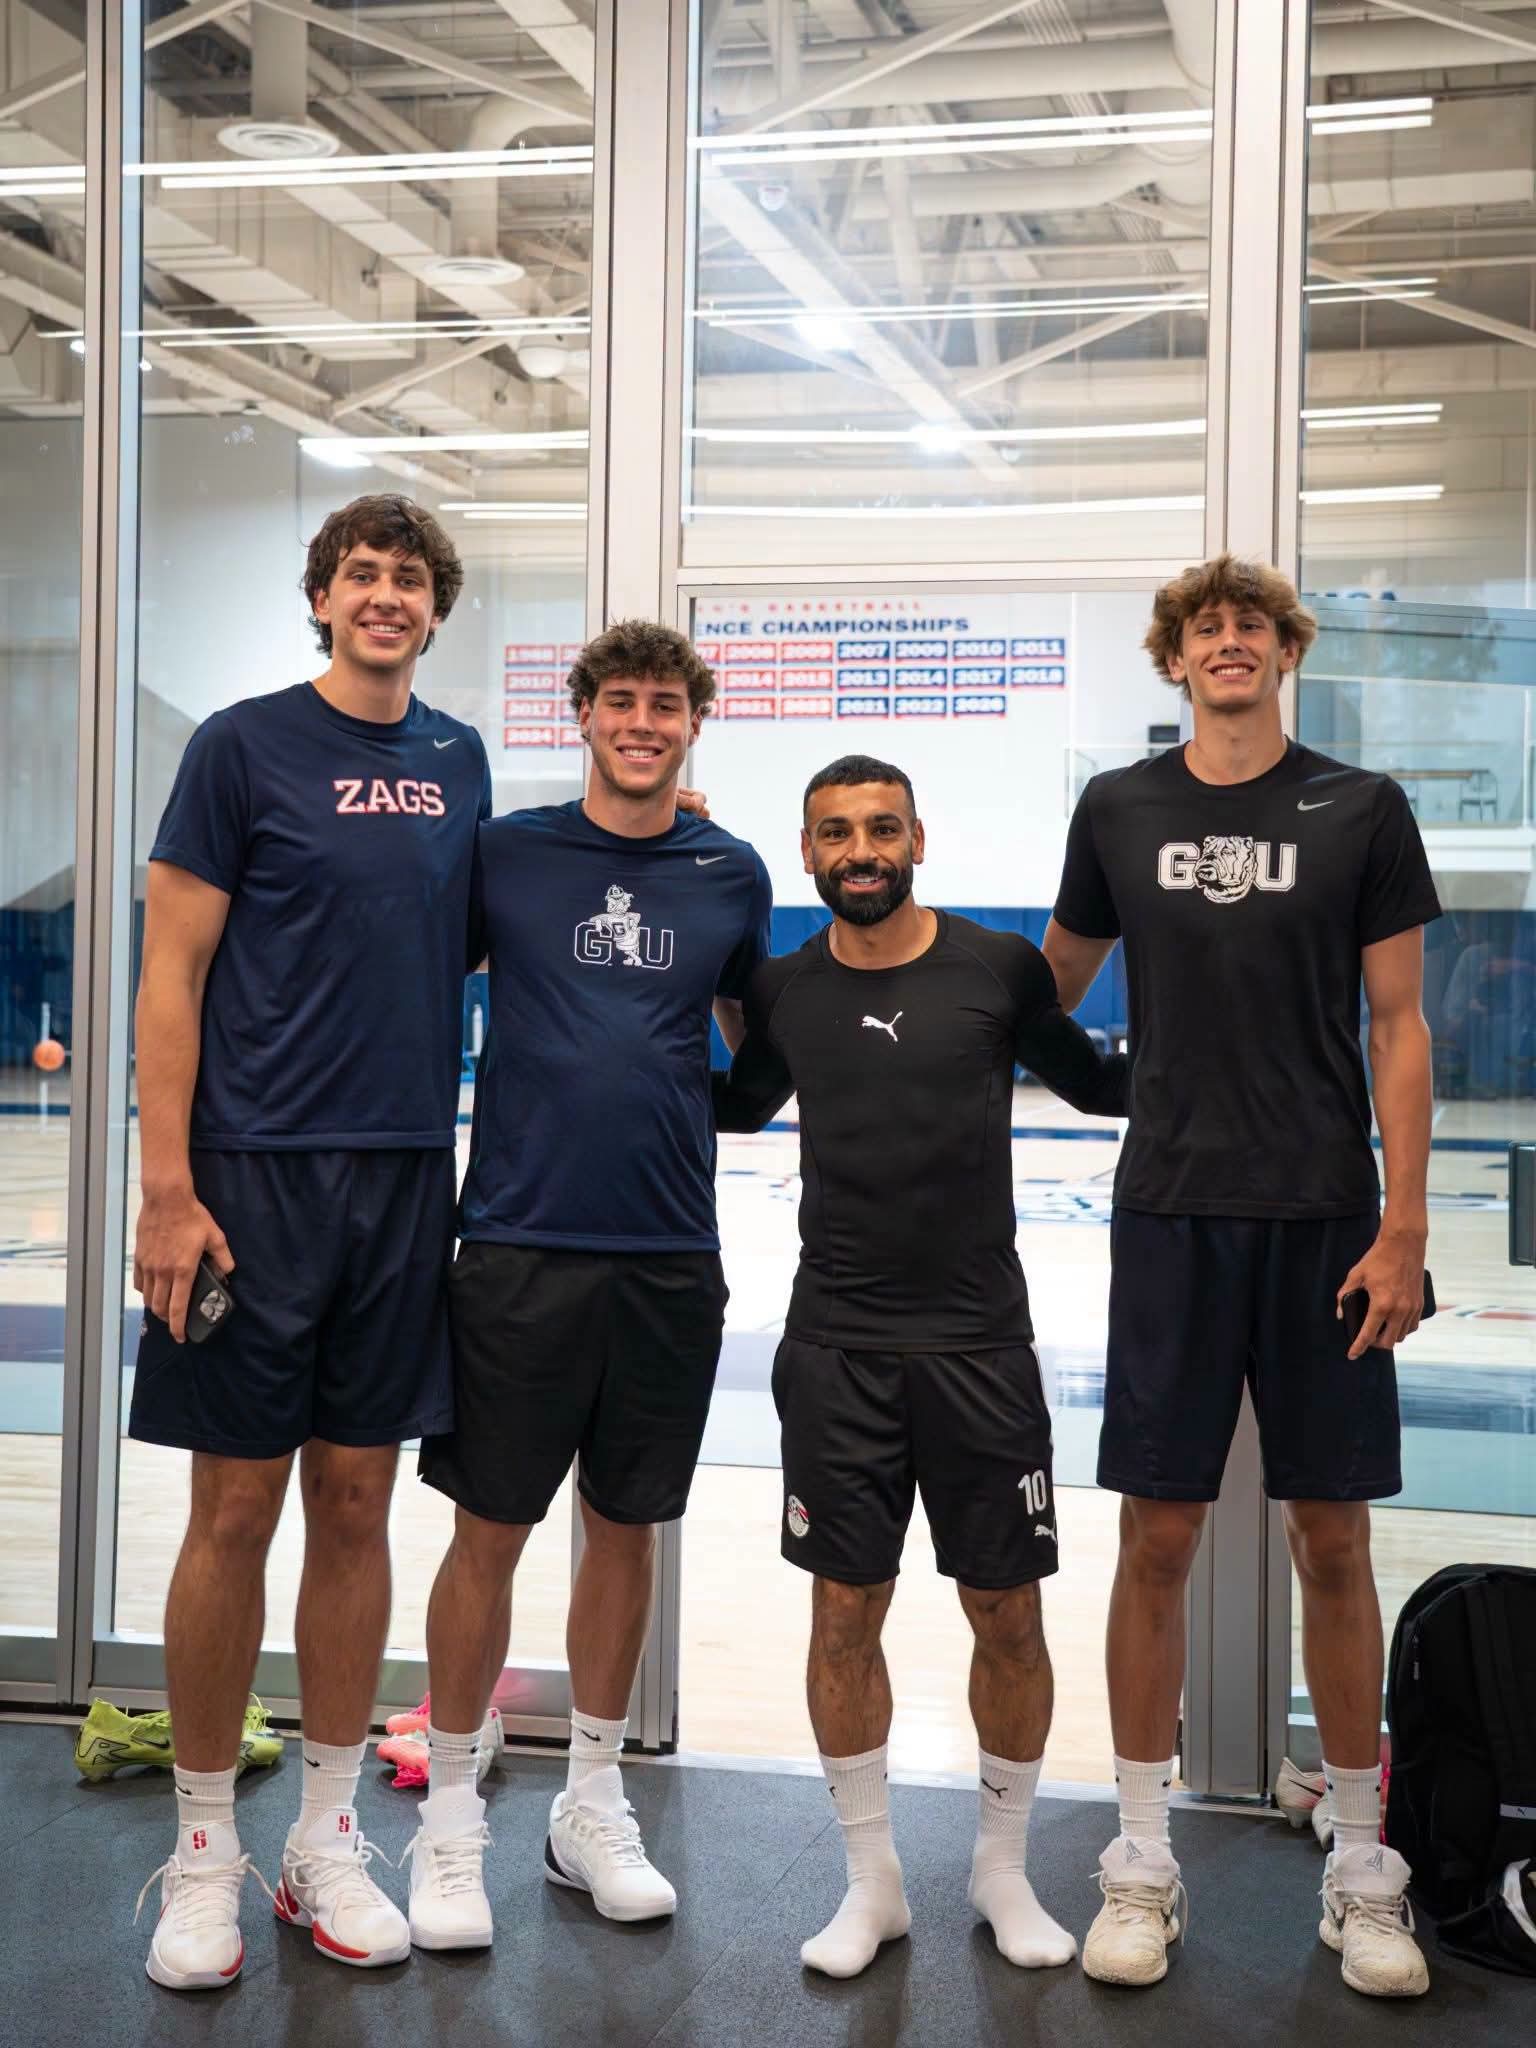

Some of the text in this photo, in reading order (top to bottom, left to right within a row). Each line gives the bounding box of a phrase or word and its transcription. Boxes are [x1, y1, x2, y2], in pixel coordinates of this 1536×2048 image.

[762, 618, 969, 636] CHAMPIONSHIPS
[840, 643, 887, 658] 2007
[897, 642, 946, 658] 2009
[955, 642, 1004, 656] 2010
[1012, 641, 1061, 655] 2011
[727, 671, 774, 687] 2014
[840, 671, 887, 685] 2013
[896, 670, 945, 685] 2014
[955, 670, 1002, 684] 2017
[1012, 669, 1062, 683] 2018
[333, 779, 446, 816] ZAGS
[1018, 1469, 1047, 1515] 10
